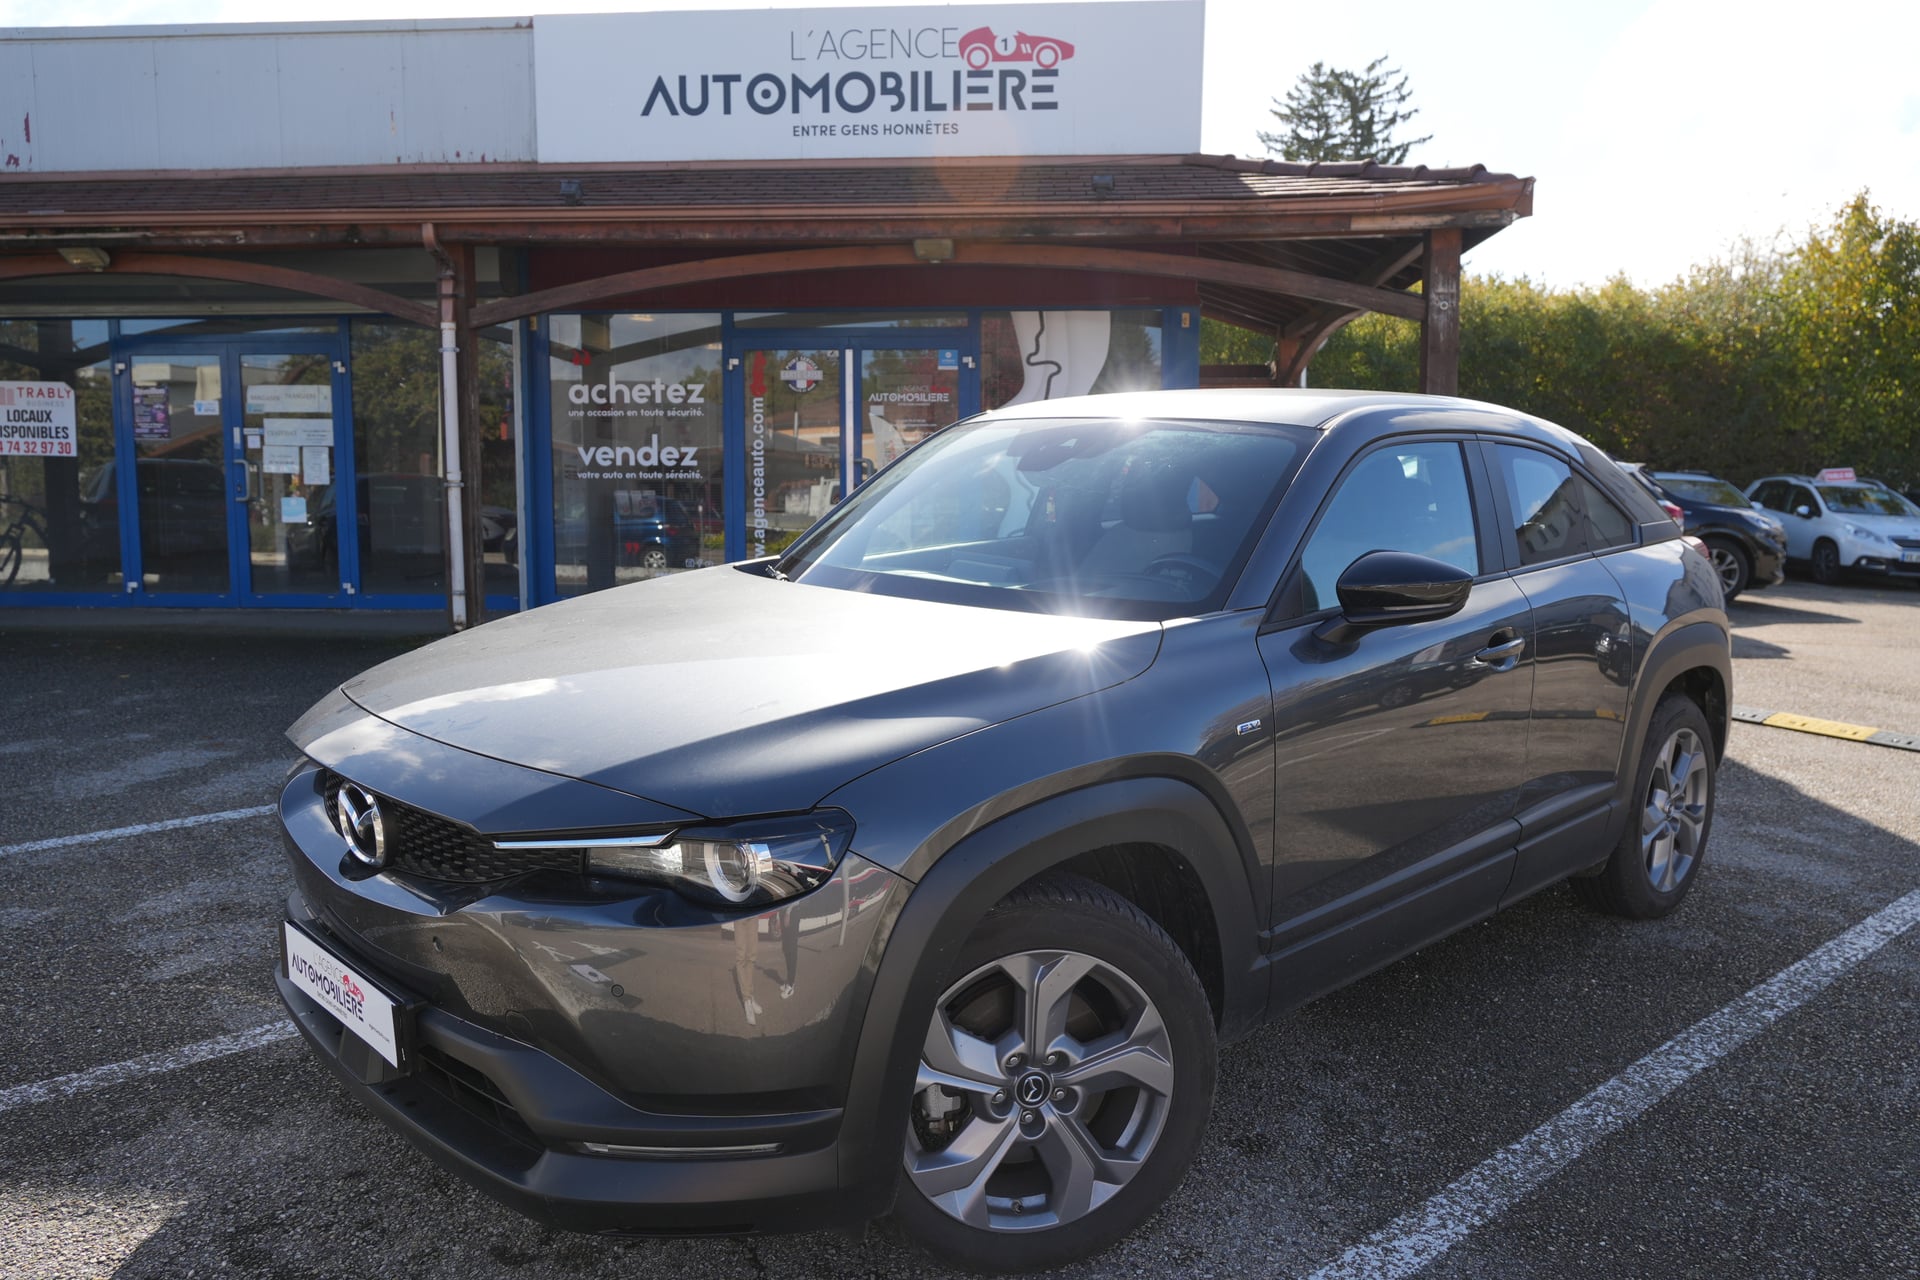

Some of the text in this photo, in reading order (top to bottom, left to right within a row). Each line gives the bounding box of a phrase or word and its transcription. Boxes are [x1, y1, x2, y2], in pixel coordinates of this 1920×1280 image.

[790, 27, 960, 61] L'AGENCE
[640, 68, 1060, 117] AUTOMOBILIERE
[792, 120, 960, 137] ENTRE GENS HONNÊTES
[16, 387, 72, 399] TRABLY
[568, 371, 705, 405] achetez
[868, 392, 950, 402] AUTOMOBILIERE
[6, 409, 53, 423] LOCAUX
[587, 408, 624, 417] occasion
[640, 408, 664, 417] toute
[667, 407, 705, 417] sécurité.
[7, 440, 20, 453] 74
[23, 441, 37, 454] 32
[41, 441, 54, 454] 97
[57, 441, 72, 455] 30
[577, 434, 698, 467] vendez
[577, 472, 600, 480] votre
[602, 471, 623, 480] auto
[639, 471, 663, 479] toute
[665, 469, 703, 480] sérénité.
[292, 952, 365, 1022] AUTOMOBILIERE
